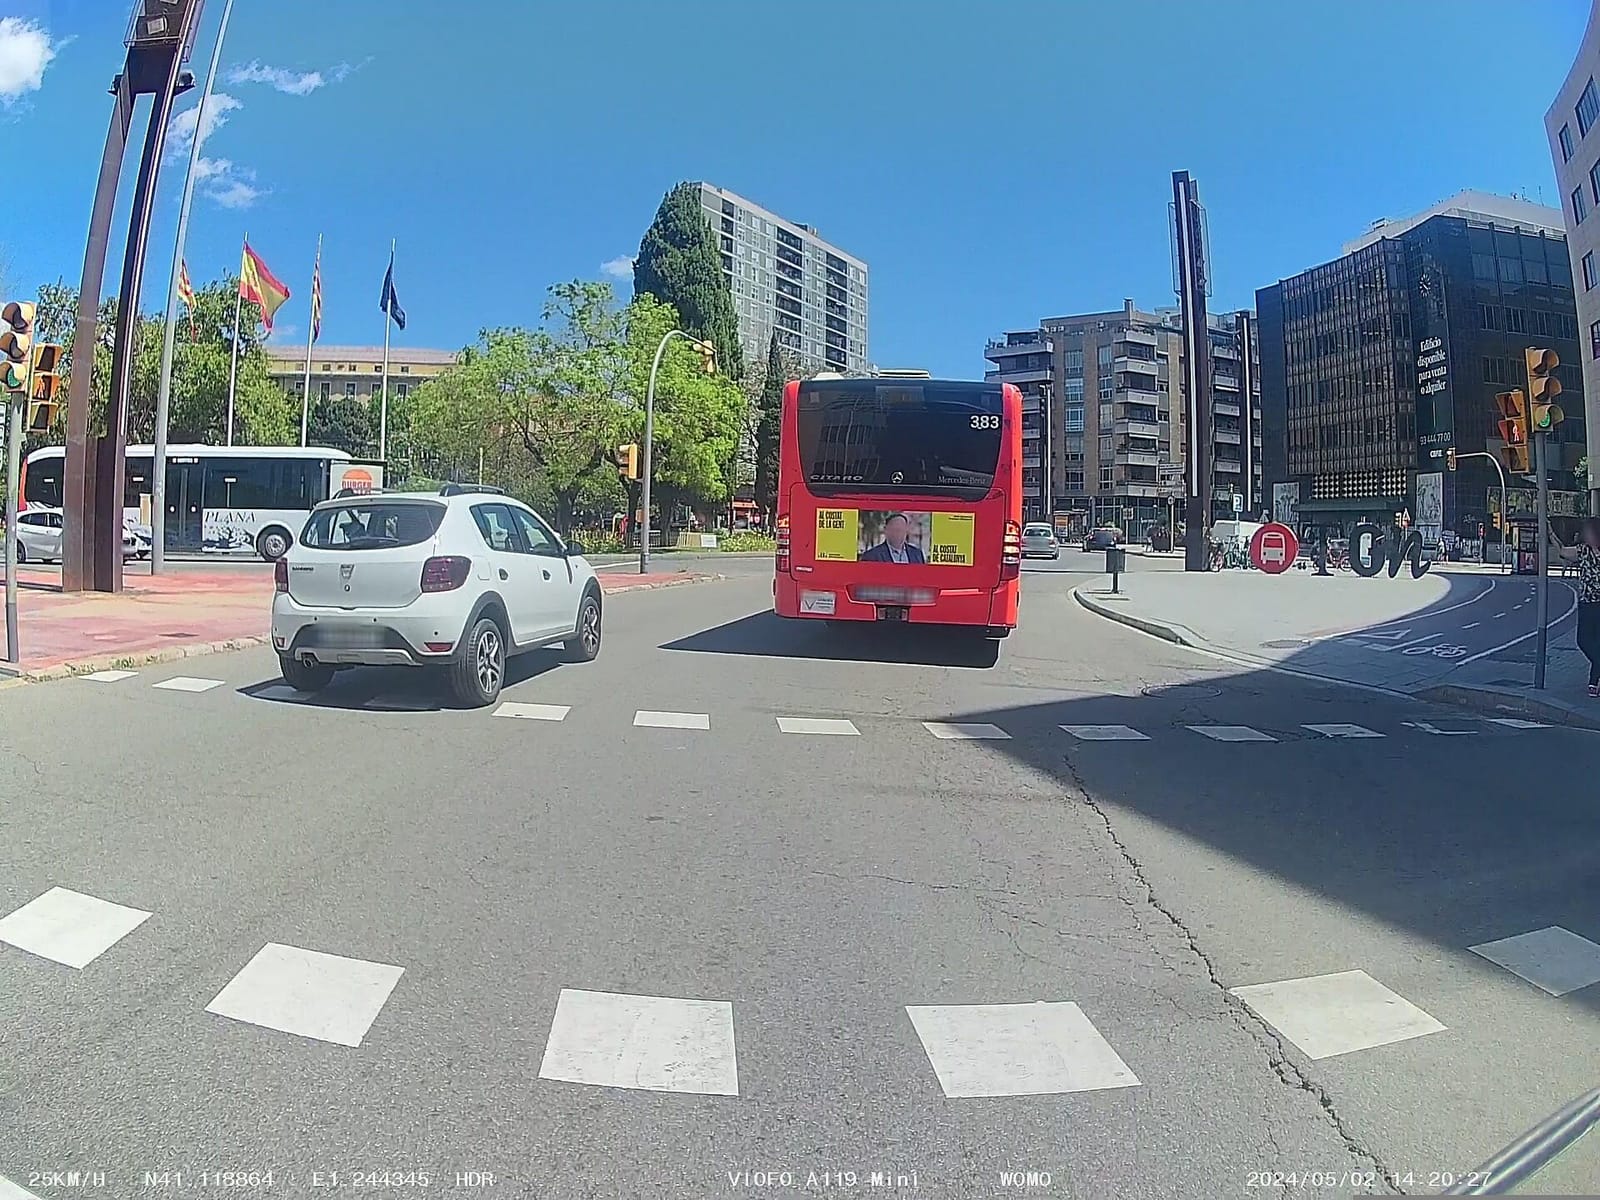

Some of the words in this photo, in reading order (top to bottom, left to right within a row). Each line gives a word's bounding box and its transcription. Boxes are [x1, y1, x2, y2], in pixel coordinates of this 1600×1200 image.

[1420, 336, 1442, 352] Edificio
[1417, 349, 1446, 368] disponible
[1418, 370, 1431, 384] para
[1431, 365, 1447, 379] venta
[1420, 386, 1426, 395] o
[1425, 379, 1447, 396] alquiler
[969, 415, 999, 429] 383
[205, 511, 255, 522] PLANA
[819, 520, 825, 528] DE
[933, 553, 939, 562] DE
